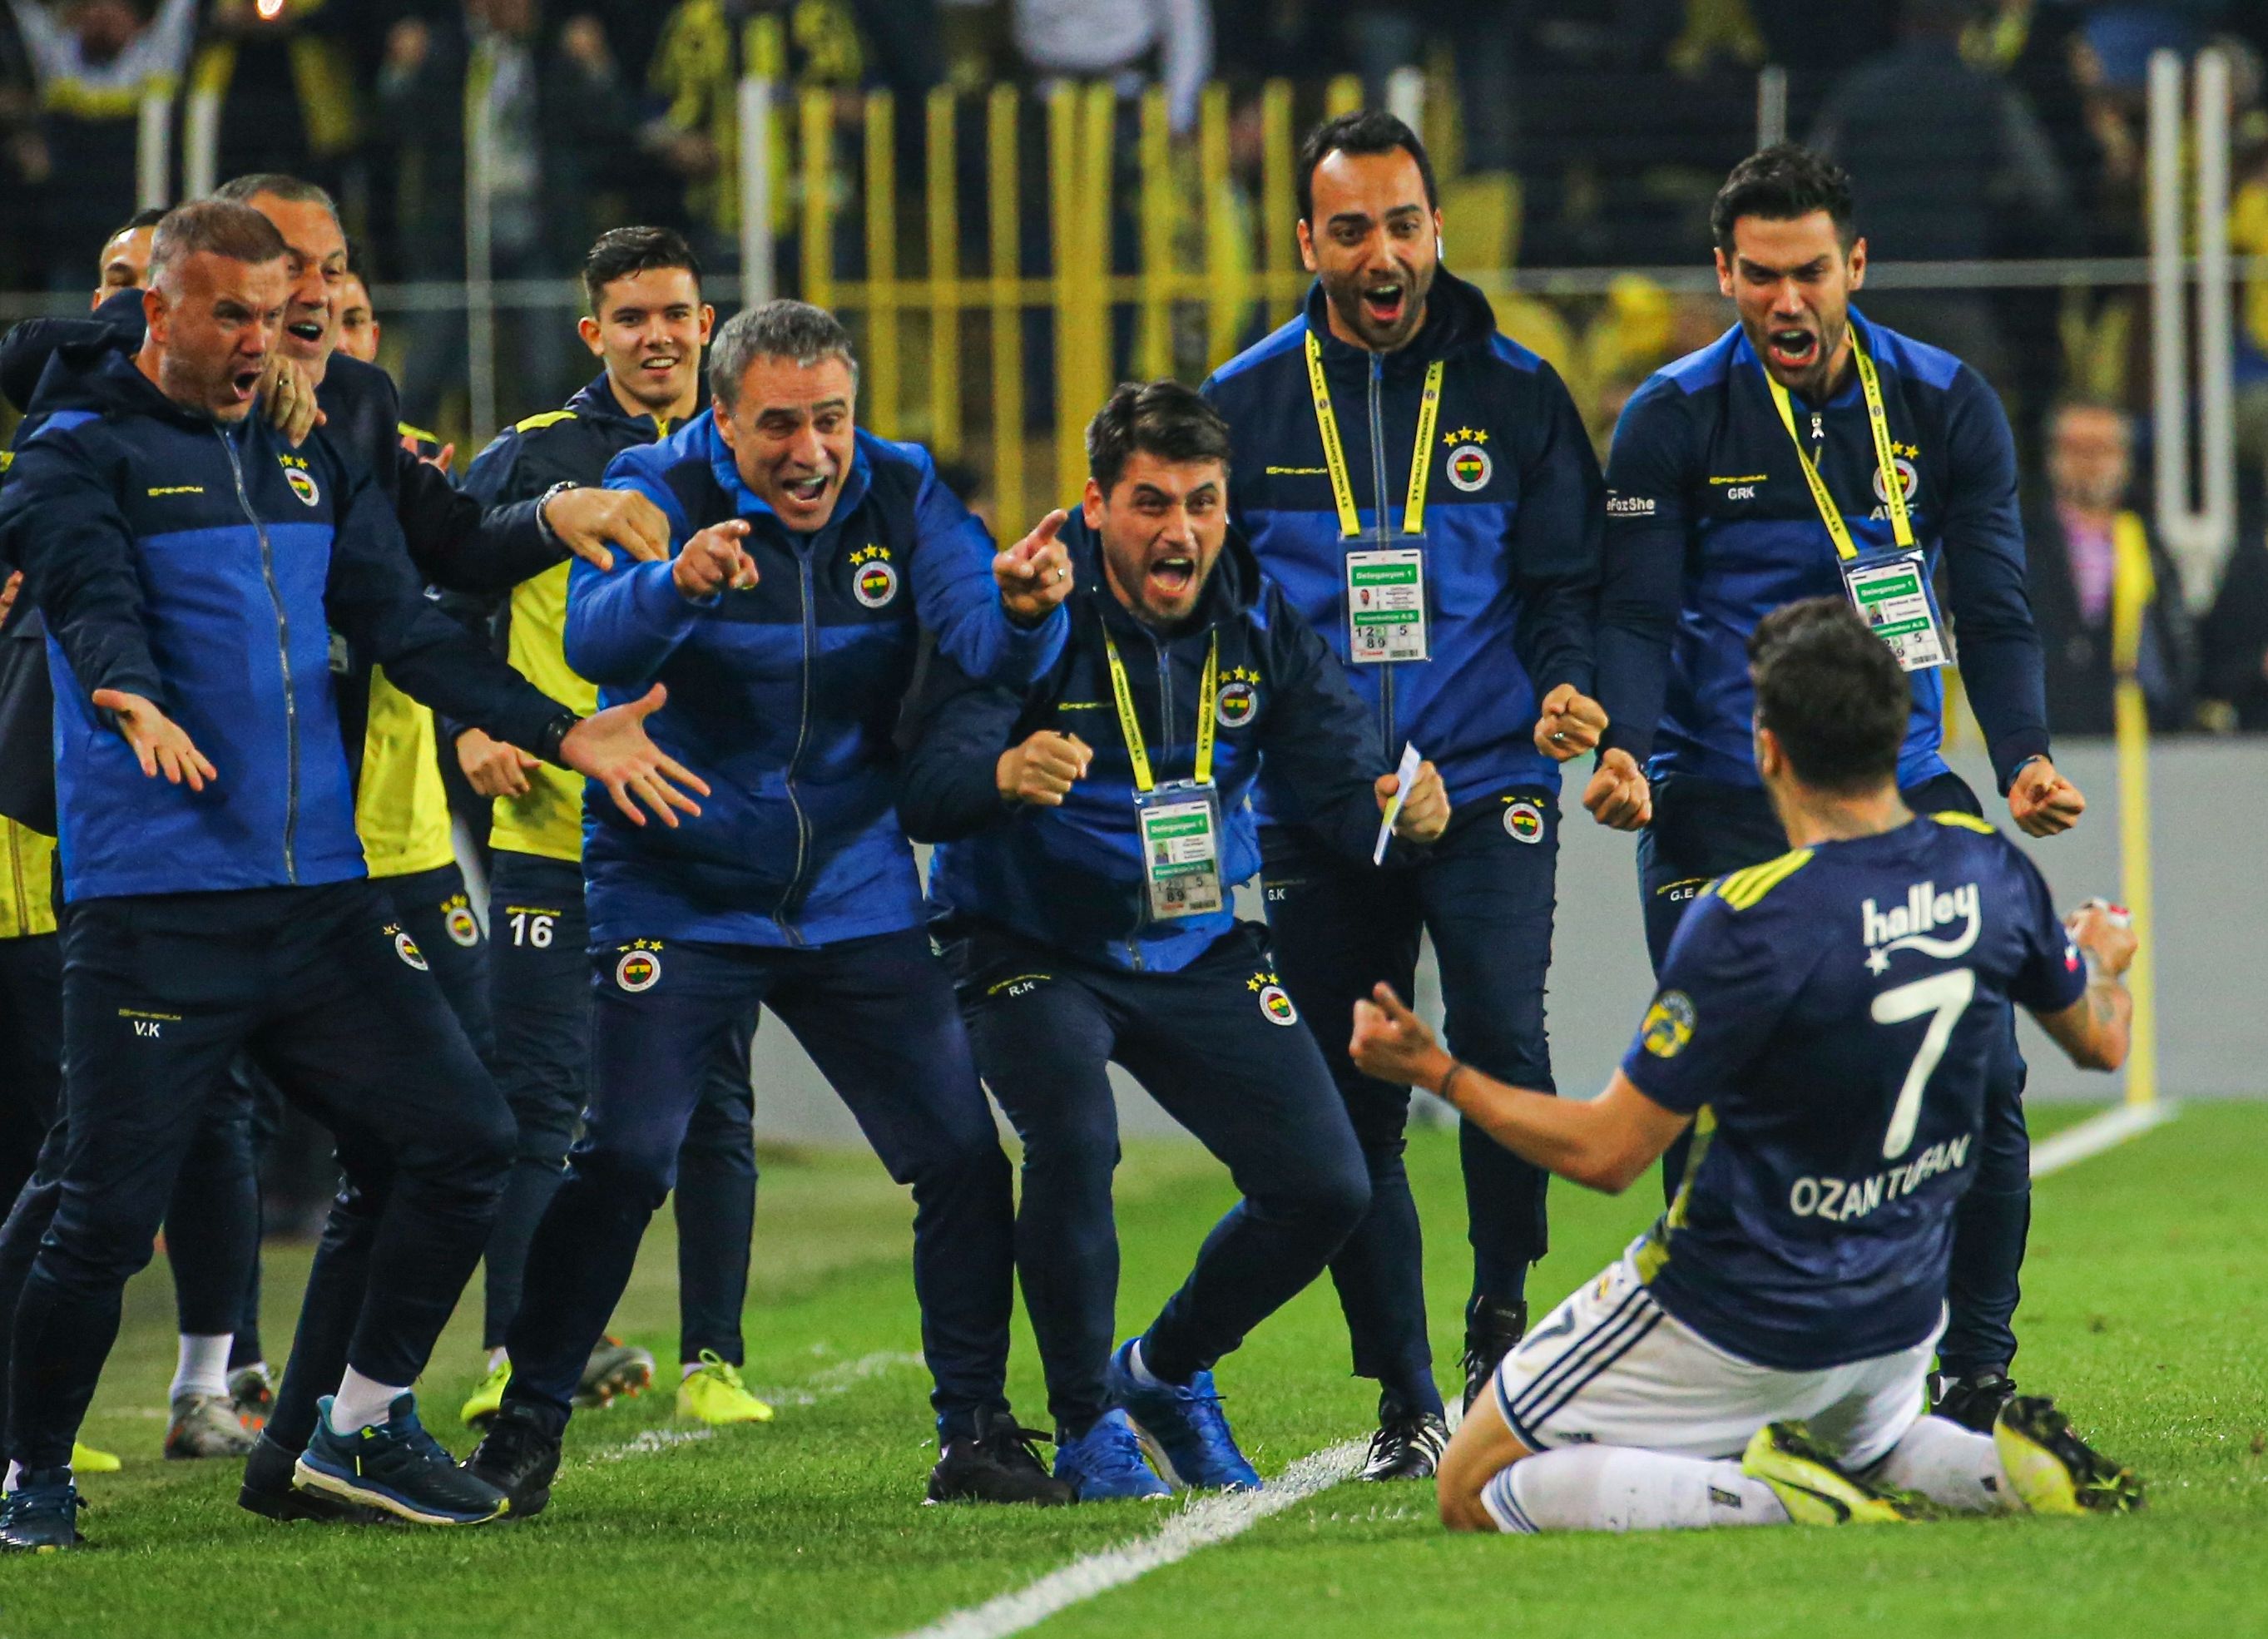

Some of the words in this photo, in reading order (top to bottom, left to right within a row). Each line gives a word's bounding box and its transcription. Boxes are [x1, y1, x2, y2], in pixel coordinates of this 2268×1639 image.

[1727, 486, 1755, 500] GRK
[1606, 498, 1655, 511] eForShe
[1355, 626, 1362, 637] 1
[1366, 626, 1374, 637] 2
[1399, 625, 1408, 636] 5
[1914, 632, 1923, 643] 5
[1366, 637, 1374, 649] 8
[1377, 637, 1386, 649] 9
[1896, 648, 1905, 657] 9
[1268, 889, 1285, 900] G.K
[1671, 888, 1694, 901] G.E
[1862, 880, 1982, 958] halley
[510, 913, 554, 948] 16
[1008, 982, 1035, 997] R.K
[134, 1021, 160, 1037] V.K
[1871, 968, 1975, 1160] 7
[1790, 1172, 1885, 1221] OZAN
[1888, 1132, 1973, 1201] TUFAN
